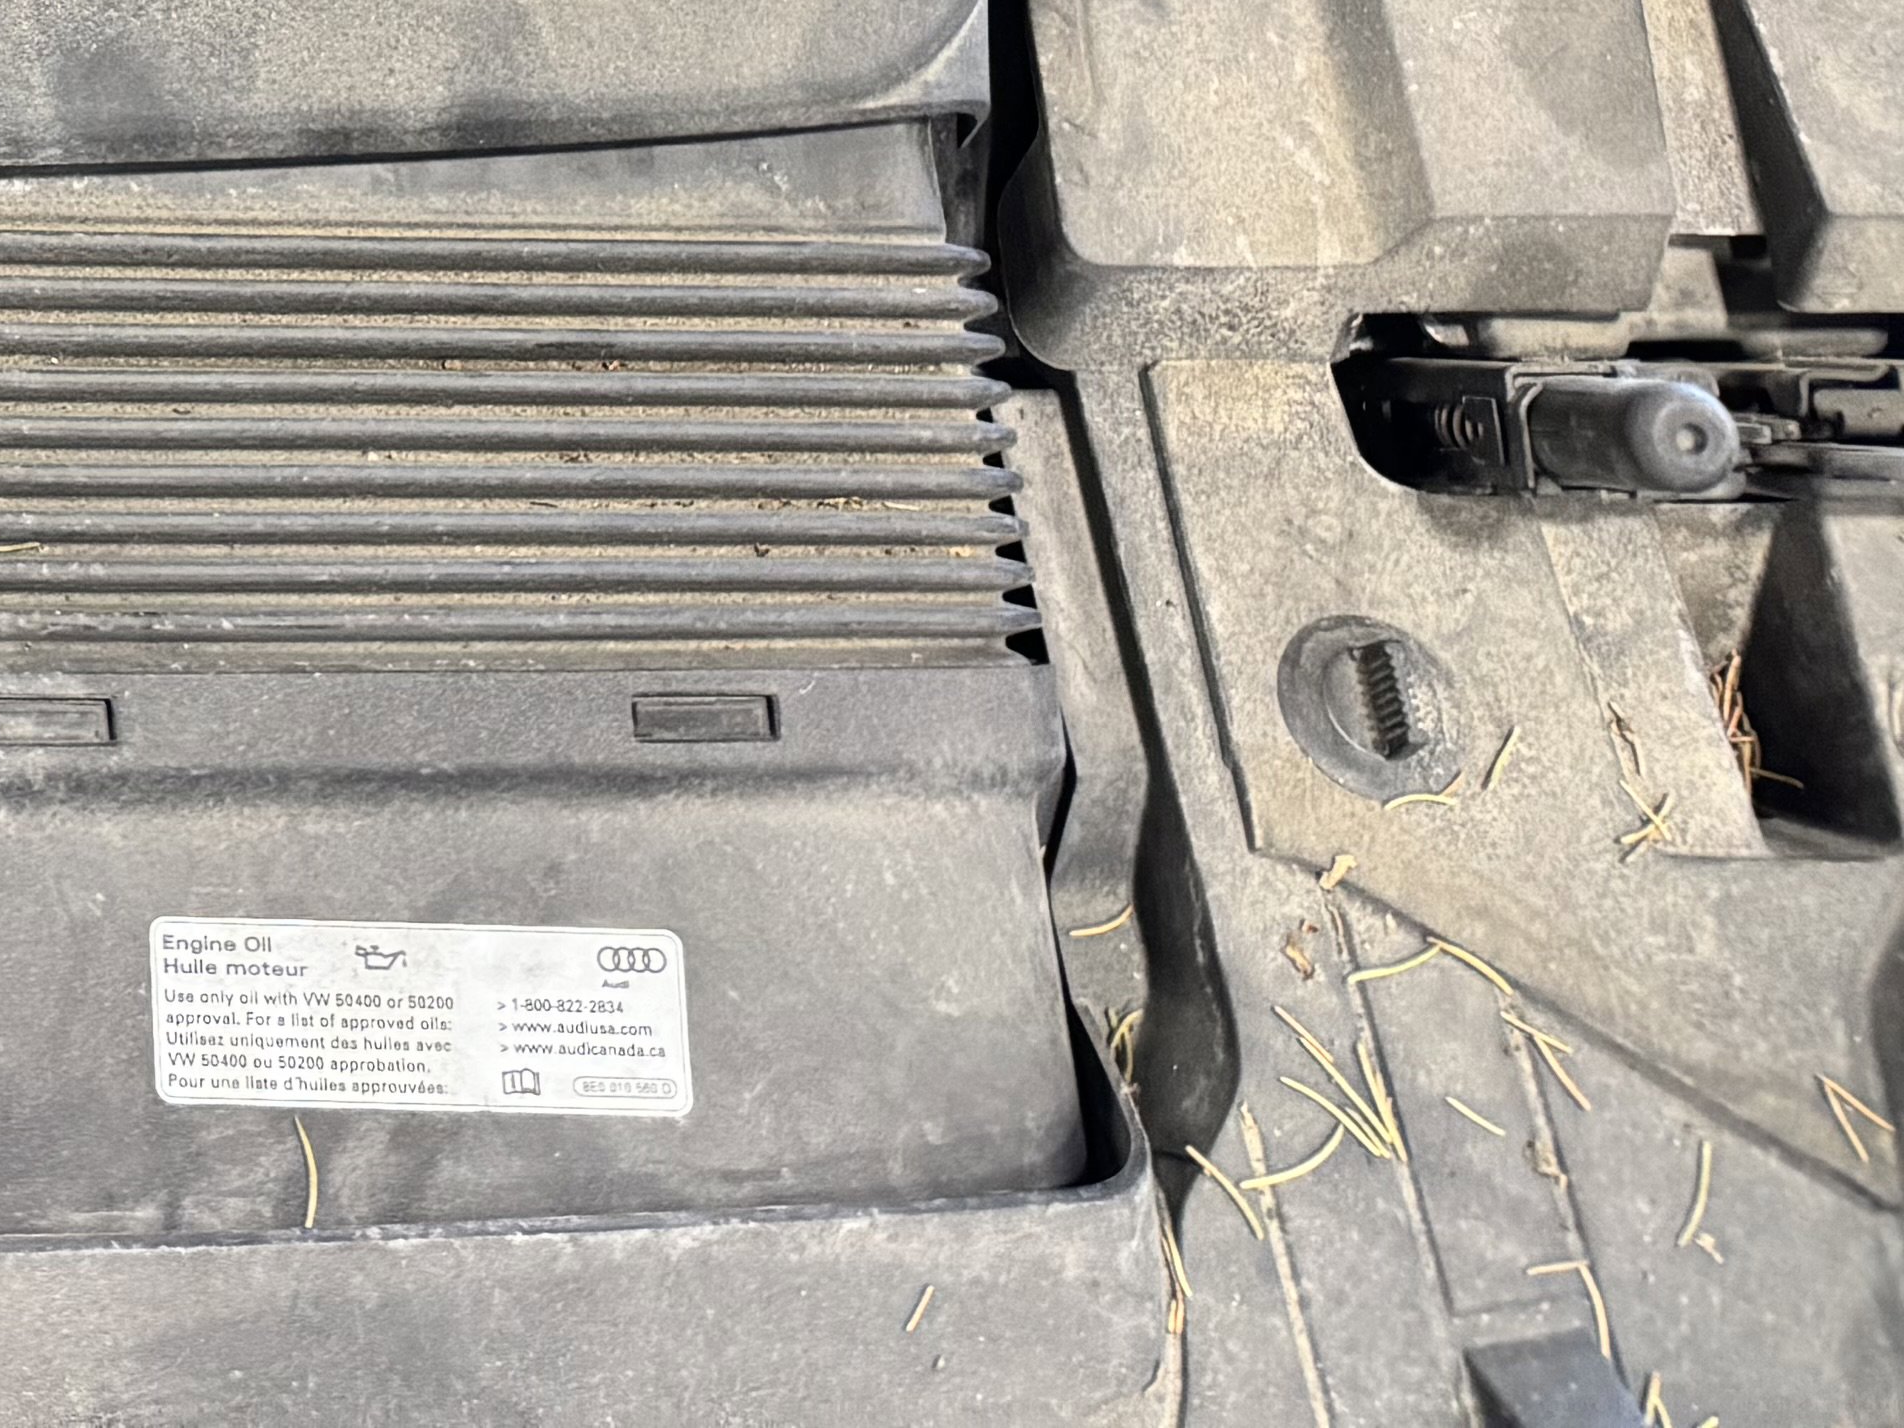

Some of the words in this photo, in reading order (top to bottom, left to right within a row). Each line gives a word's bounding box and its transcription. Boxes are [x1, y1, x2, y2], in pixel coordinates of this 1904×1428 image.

[162, 934, 237, 954] Engine
[244, 936, 273, 953] Oil
[163, 958, 218, 975] Huile
[226, 961, 309, 977] moteur
[164, 989, 195, 1003] Use
[199, 991, 234, 1007] only
[239, 991, 259, 1005] oil
[265, 991, 298, 1006] with
[303, 993, 331, 1006] VW
[335, 993, 382, 1008] 50400
[386, 996, 403, 1008] or
[408, 995, 454, 1010] 50200
[511, 997, 625, 1013] 1-800-822-2834
[166, 1012, 241, 1026] approval.
[245, 1012, 271, 1026] For
[277, 1015, 286, 1026] a
[291, 1013, 314, 1027] list
[320, 1013, 336, 1028] of
[341, 1015, 415, 1033] approved
[420, 1016, 454, 1031] oils:
[511, 1020, 653, 1037] www.audiusa.com
[166, 1032, 225, 1046] Utilisez
[229, 1033, 326, 1050] uniquement
[330, 1035, 359, 1050] des
[363, 1036, 410, 1051] huiles
[416, 1040, 453, 1052] avec
[513, 1041, 666, 1058] www.audicanada.ca
[167, 1052, 196, 1067] VW
[201, 1053, 247, 1068] 50400
[253, 1057, 273, 1068] ou
[278, 1055, 324, 1070] 50200
[330, 1057, 432, 1074] approbation.
[167, 1073, 206, 1089] Pour
[211, 1076, 240, 1089] une
[245, 1075, 278, 1090] liste
[283, 1076, 347, 1092] d'huiles
